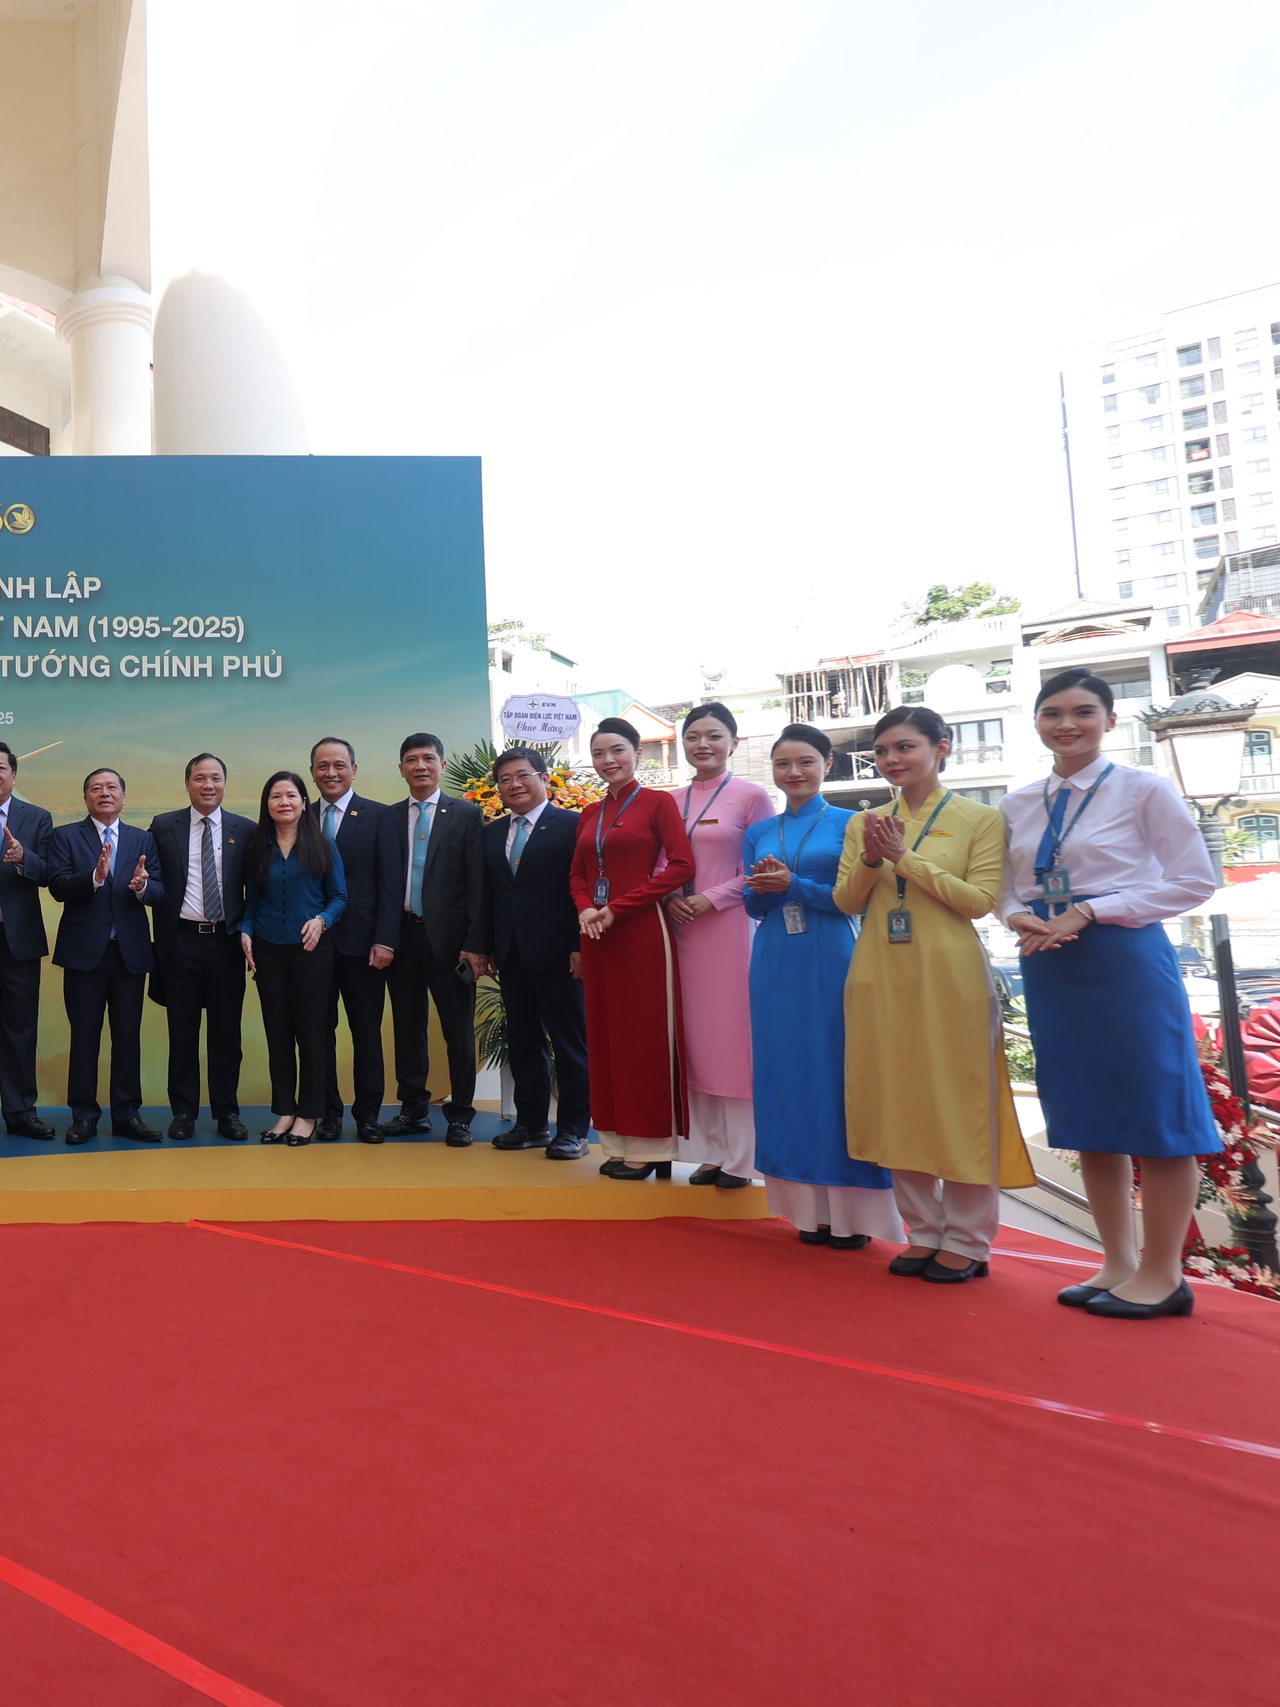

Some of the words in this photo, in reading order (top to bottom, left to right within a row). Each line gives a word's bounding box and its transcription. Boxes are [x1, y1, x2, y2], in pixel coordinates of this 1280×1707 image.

[45, 570, 102, 603] LẬP
[13, 615, 79, 638] NAM
[88, 615, 245, 643] (1995-2025)
[119, 649, 213, 678] CHÍNH
[223, 649, 283, 678] PHỦ
[516, 721, 537, 732] Chúc
[538, 722, 564, 734] Mừng
